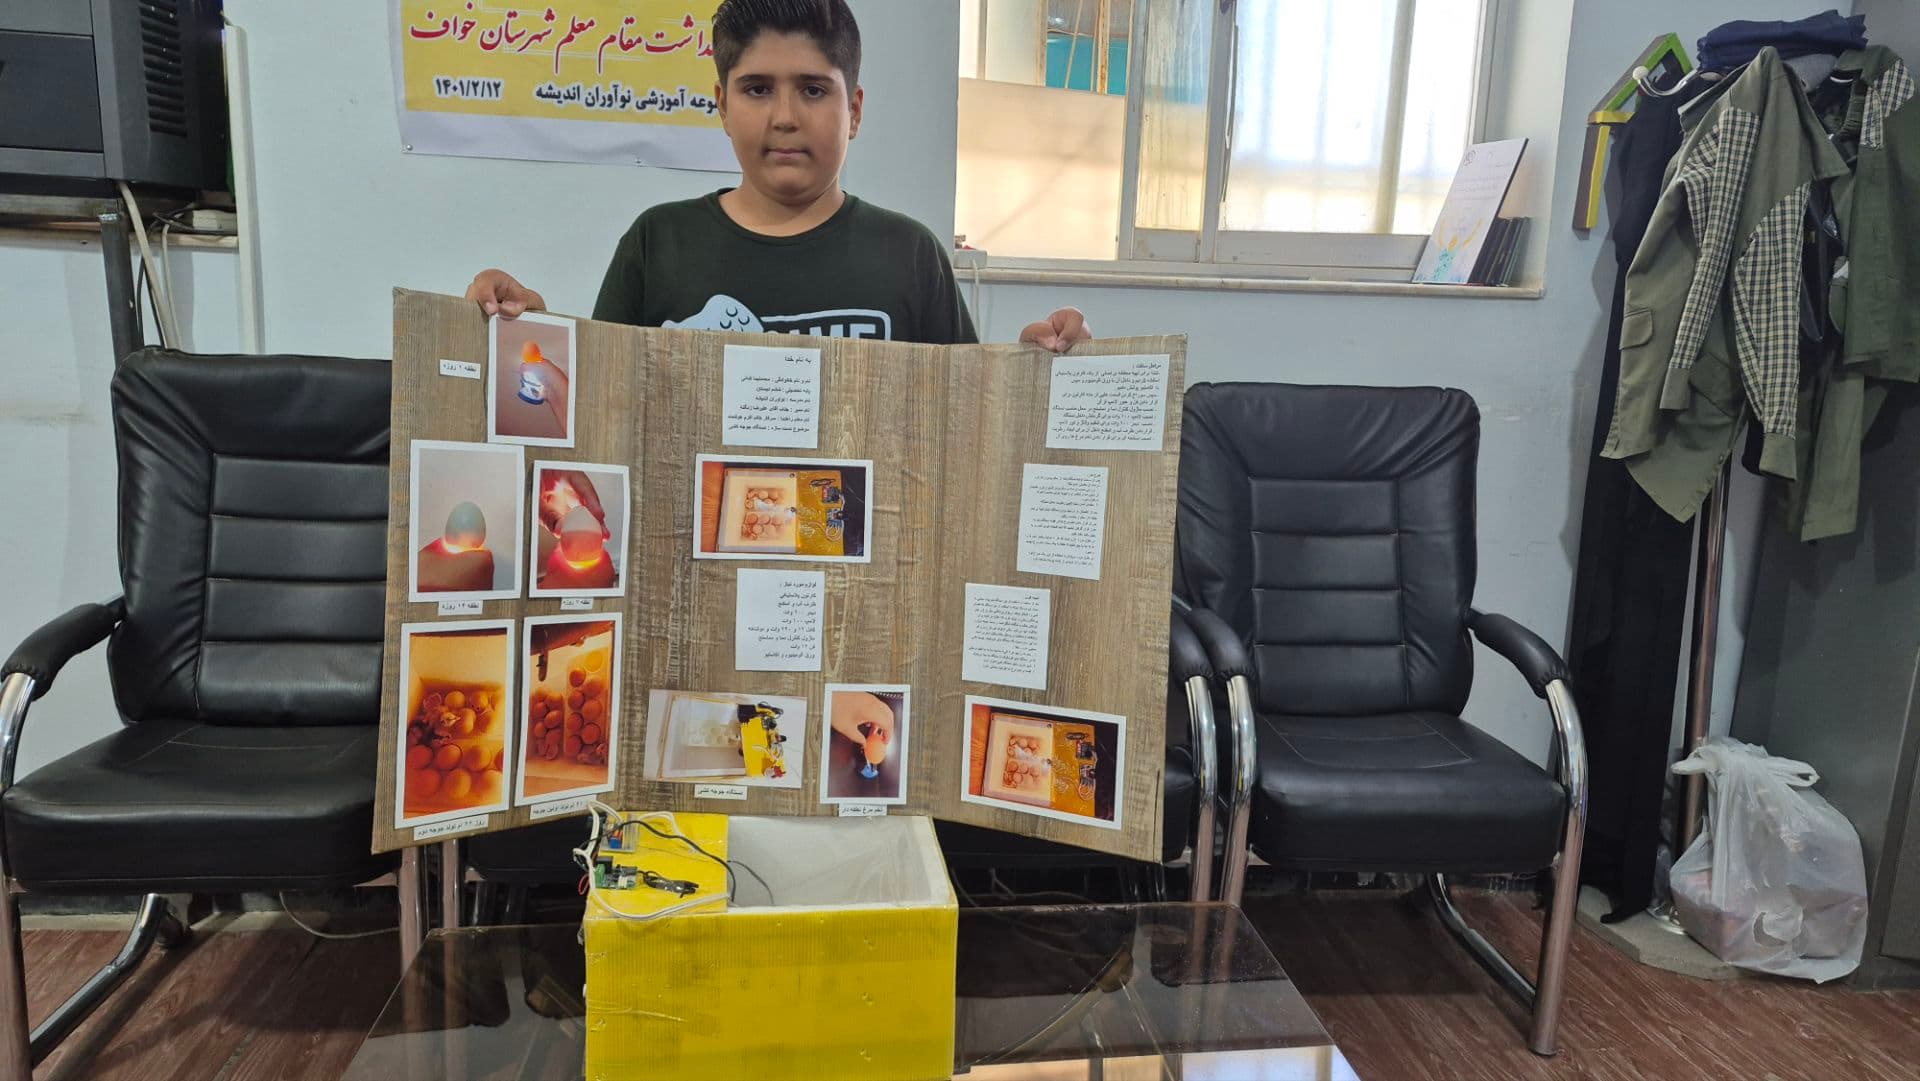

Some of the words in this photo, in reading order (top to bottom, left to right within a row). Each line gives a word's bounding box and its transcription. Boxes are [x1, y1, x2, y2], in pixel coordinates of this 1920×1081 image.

[411, 2, 477, 40] خواف
[479, 8, 556, 51] شهرستان
[555, 16, 595, 74] معلم
[597, 17, 643, 74] مقام
[535, 85, 581, 104] اندیشه
[585, 84, 632, 110] نوآوران
[636, 88, 686, 112] آموزشی
